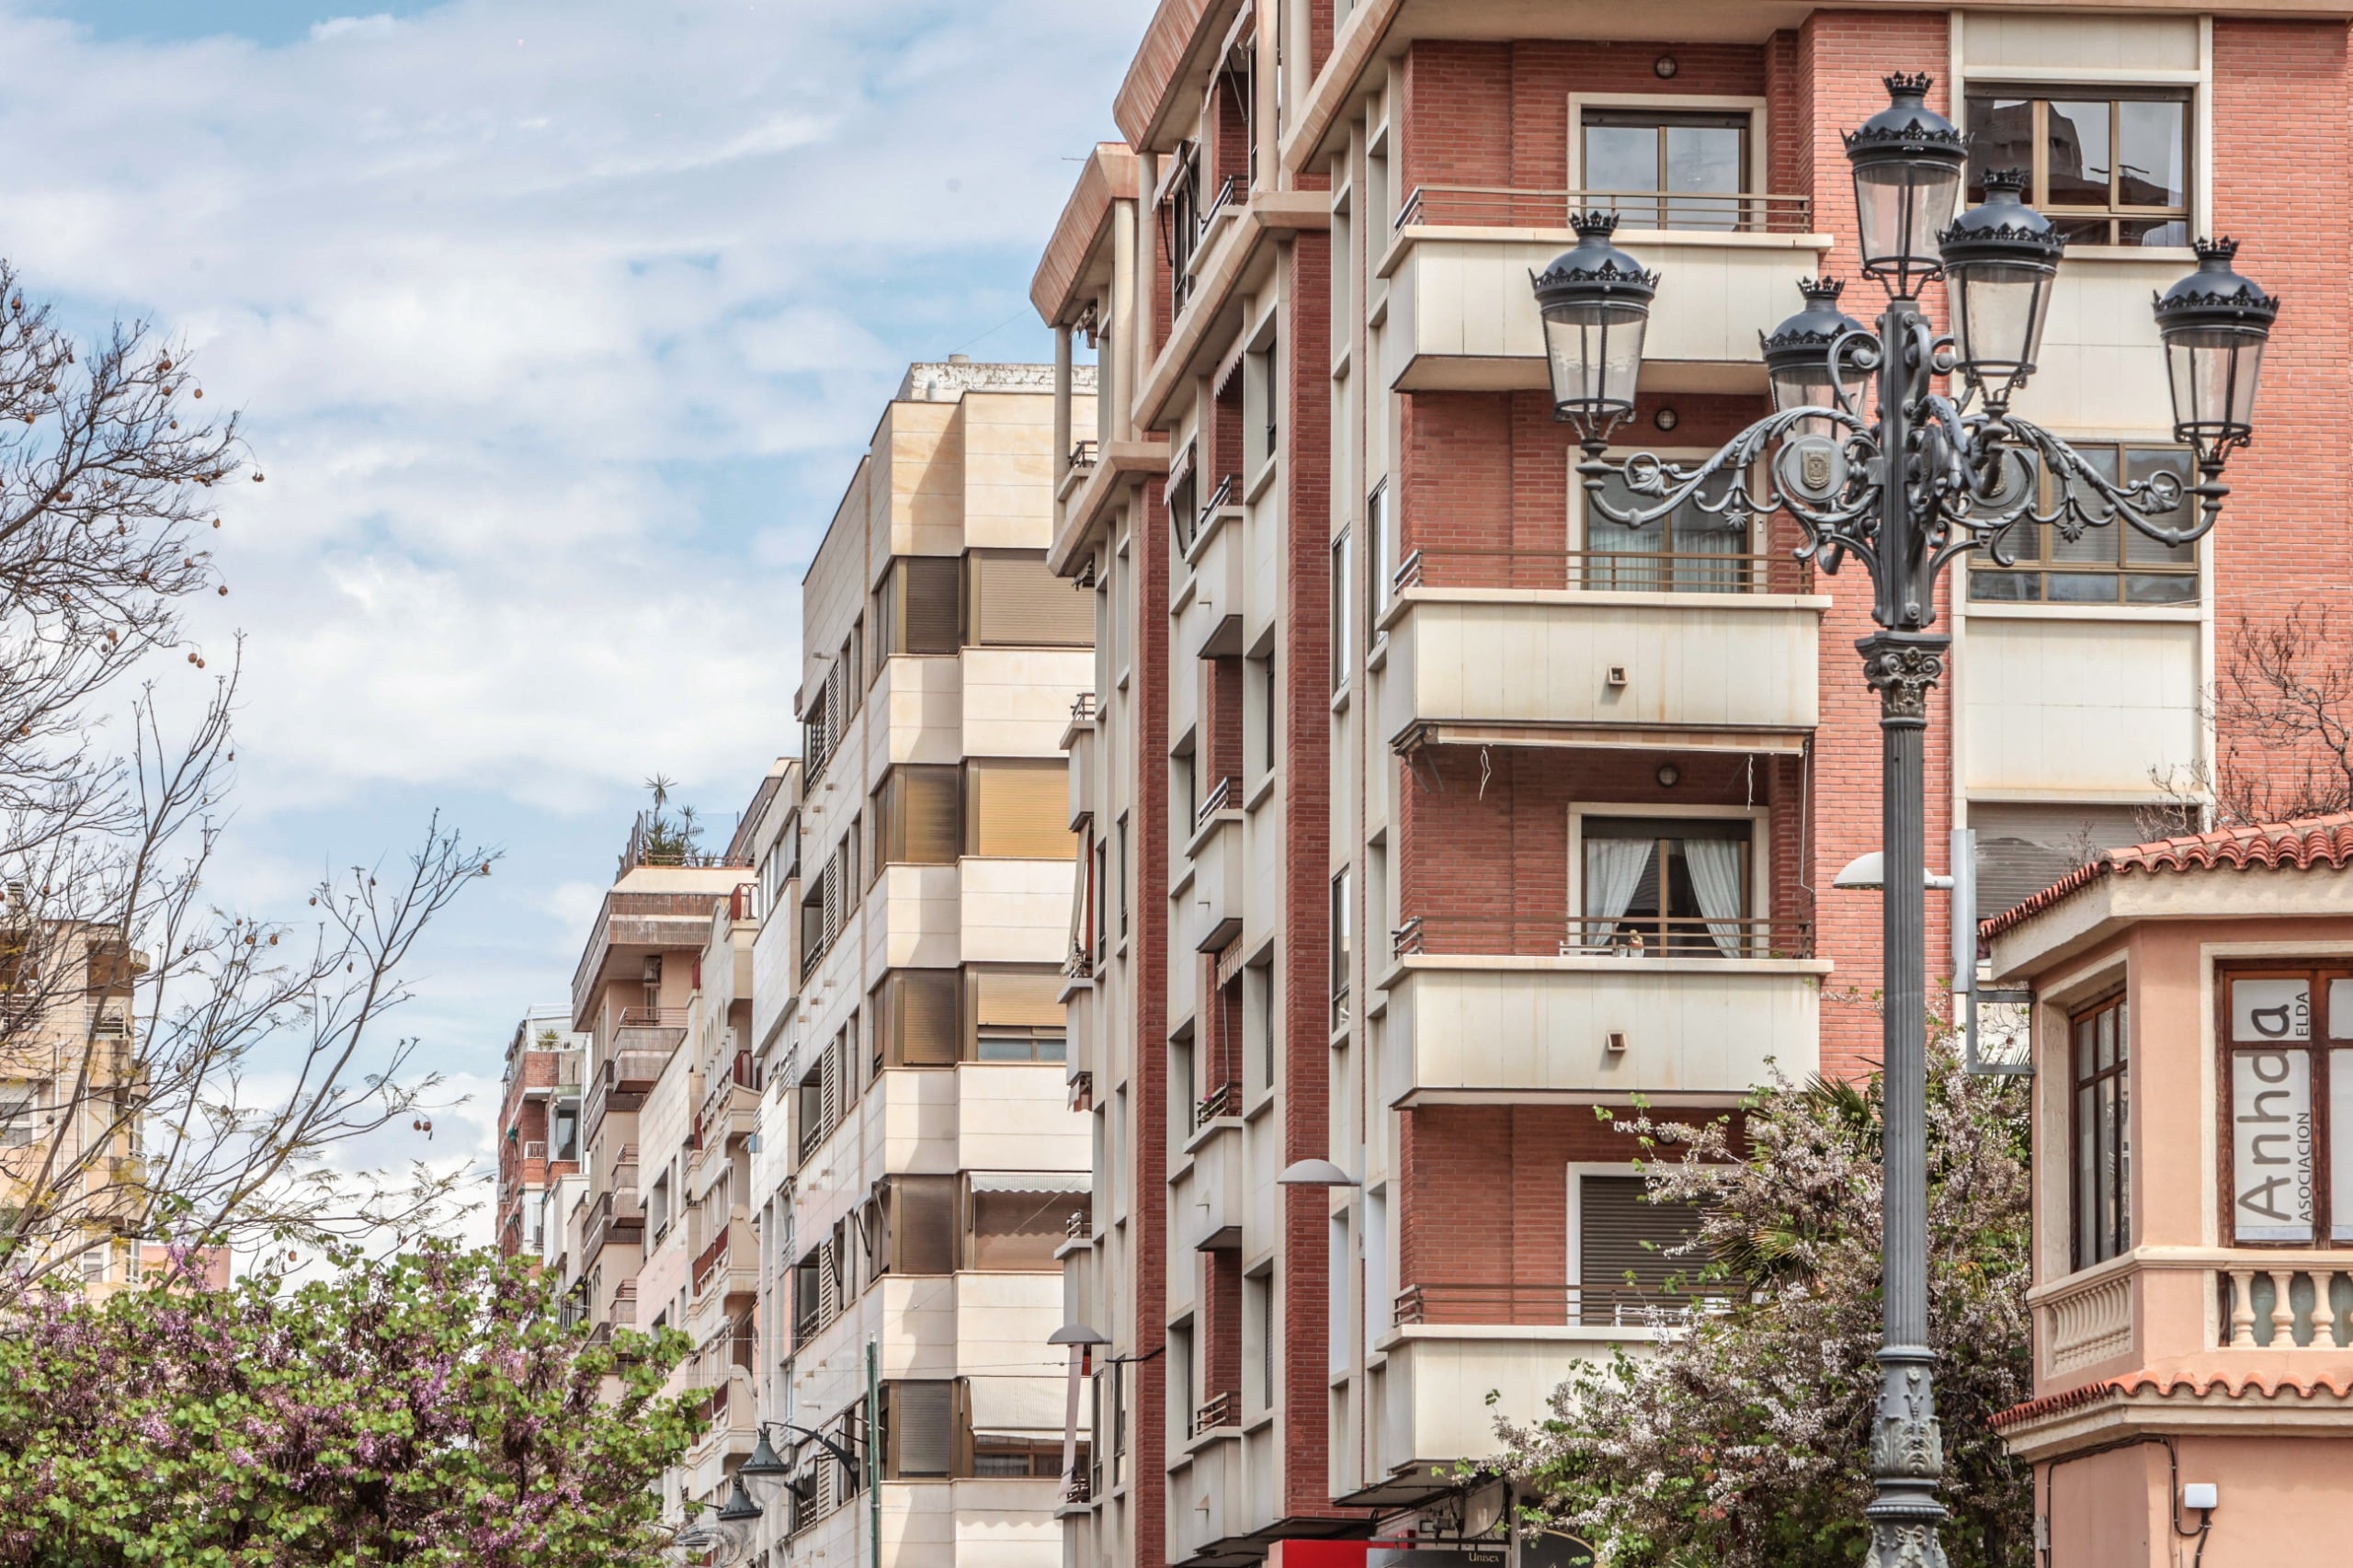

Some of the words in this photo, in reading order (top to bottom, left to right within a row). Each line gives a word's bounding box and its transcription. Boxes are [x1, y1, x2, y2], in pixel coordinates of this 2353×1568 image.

[2296, 992, 2309, 1037] ELDA
[2234, 1004, 2291, 1221] Anhda
[2297, 1112, 2312, 1221] ASOCIACION
[1469, 1551, 1500, 1562] Unisex
